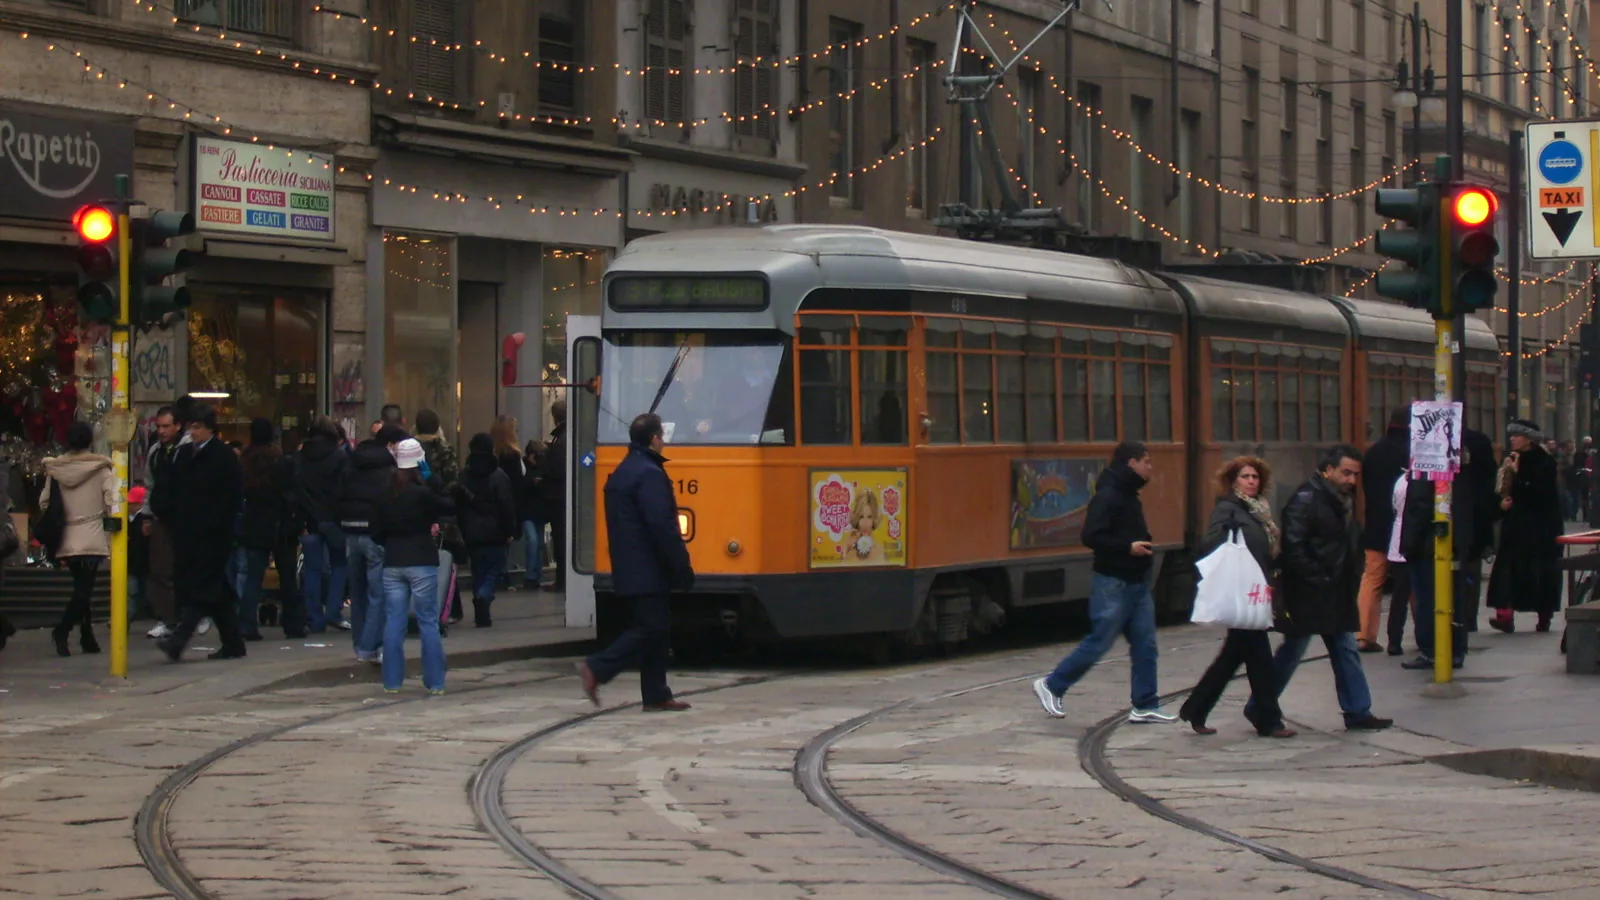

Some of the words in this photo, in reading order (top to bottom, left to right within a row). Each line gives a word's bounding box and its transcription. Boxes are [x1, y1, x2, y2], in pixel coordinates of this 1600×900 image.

[0, 118, 101, 199] Rapetti
[219, 147, 299, 189] Pasticceria
[299, 175, 331, 191] SICILIANA
[204, 185, 238, 201] CANNOLI
[249, 190, 282, 206] CASSATE
[1543, 191, 1582, 205] TAXI
[309, 196, 329, 209] CALDE
[203, 207, 240, 223] PASTIERE
[252, 211, 281, 226] GELATI
[293, 215, 325, 230] GRANITE
[672, 479, 699, 495] 16
